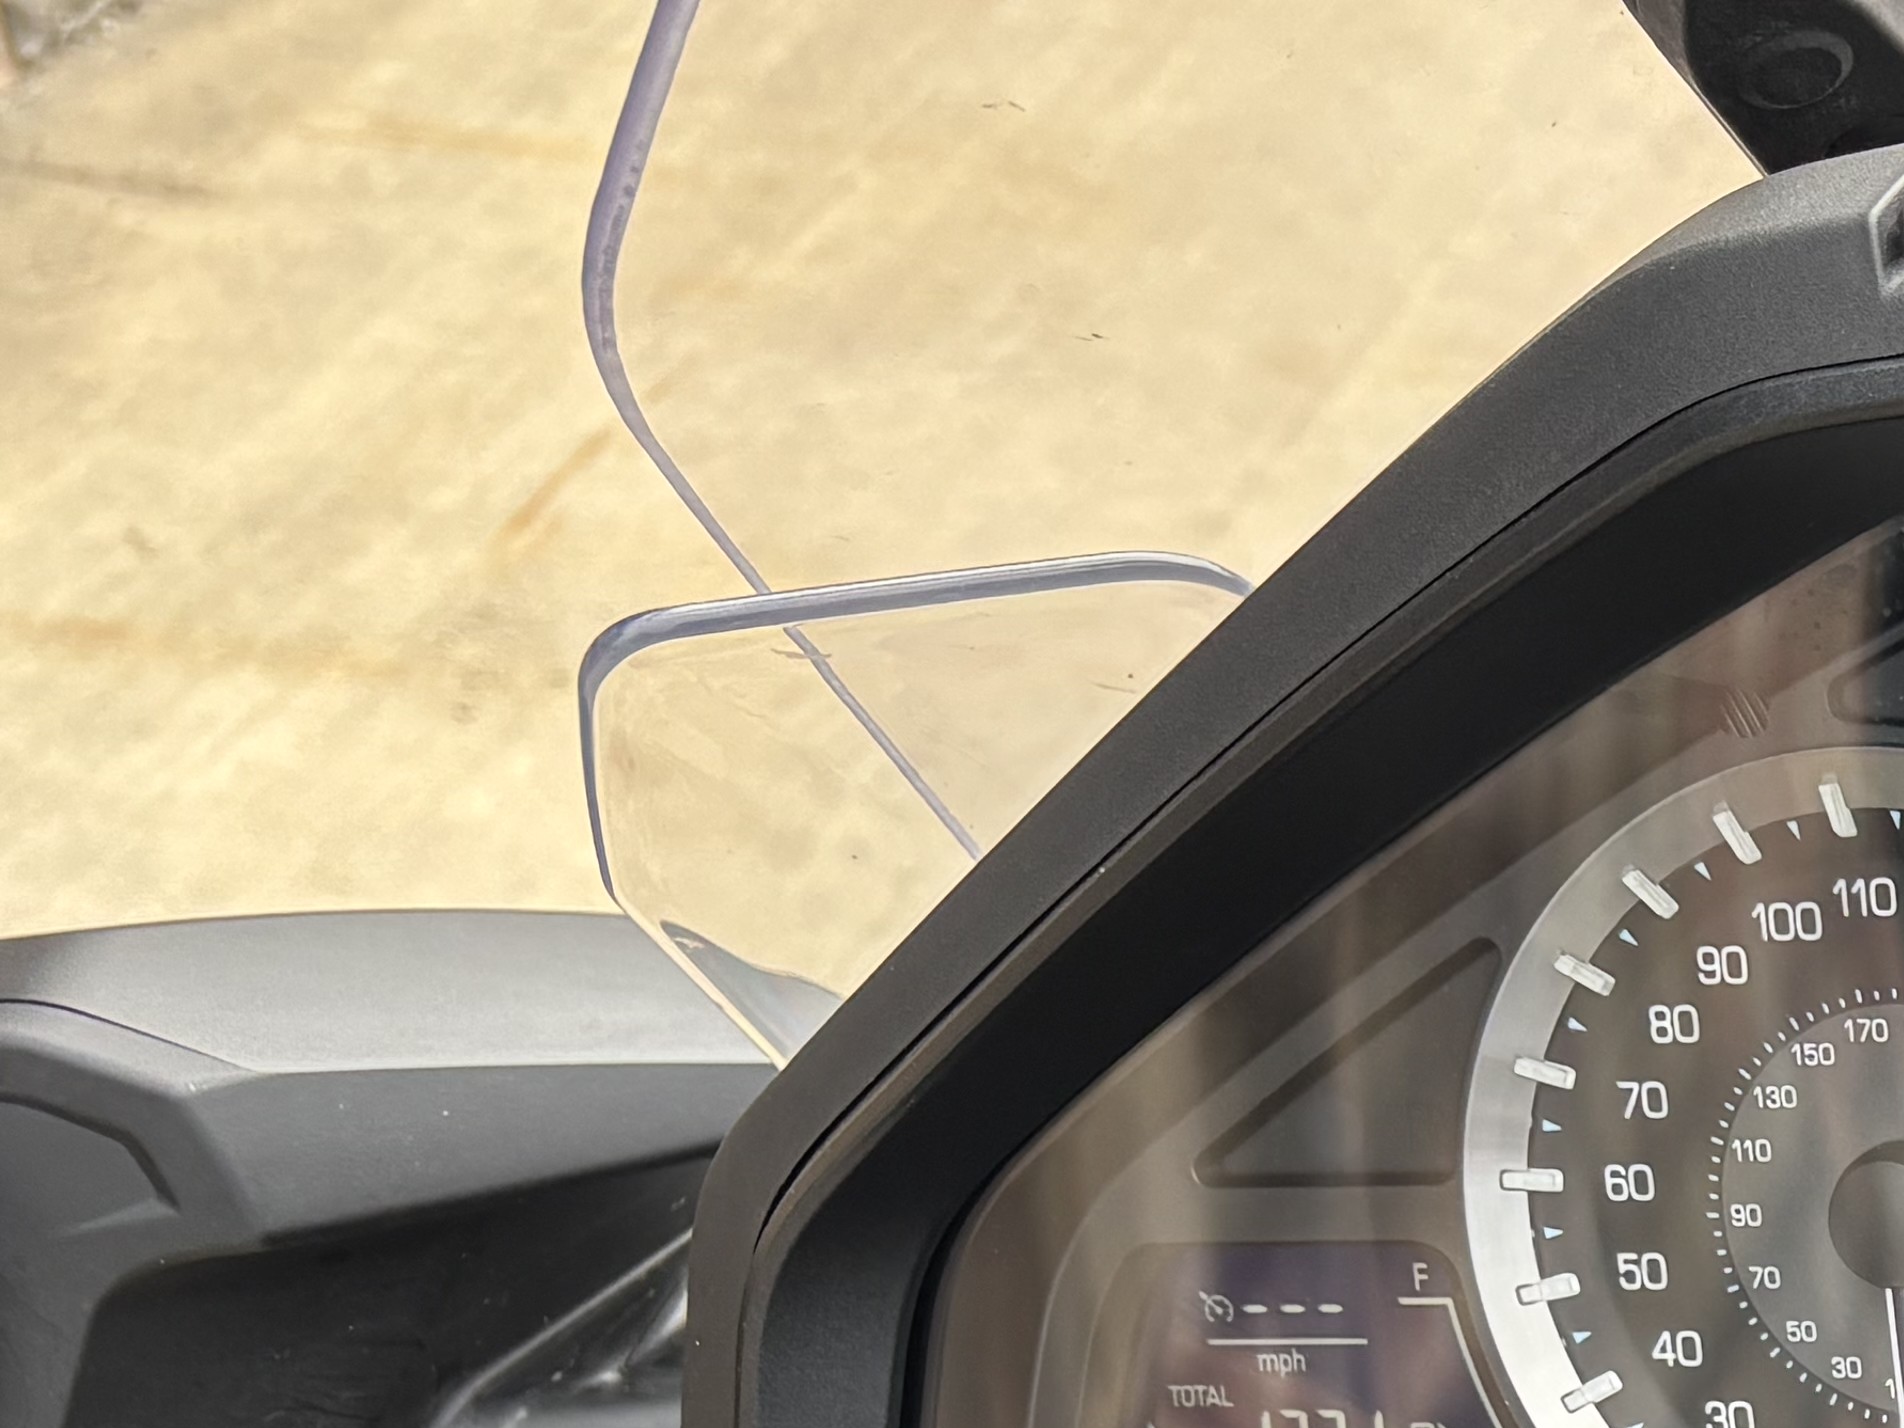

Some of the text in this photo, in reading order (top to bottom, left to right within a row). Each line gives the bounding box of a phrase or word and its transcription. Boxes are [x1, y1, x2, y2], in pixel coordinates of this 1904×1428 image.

[1833, 877, 1897, 917] 110
[1752, 902, 1822, 941] 100
[1697, 945, 1748, 985] 90
[1649, 1004, 1699, 1043] 80
[1844, 1018, 1888, 1042] 170
[1791, 1043, 1835, 1066] 150
[1616, 1081, 1668, 1119] 70
[1753, 1085, 1797, 1109] 130
[1732, 1139, 1771, 1162] 110
[1605, 1164, 1655, 1201] 60
[1730, 1203, 1762, 1227] 90
[1413, 1263, 1428, 1291] F
[1617, 1253, 1667, 1290] 50
[1749, 1266, 1780, 1289] 70
[1786, 1321, 1817, 1342] 50
[1256, 1349, 1306, 1377] mph
[1652, 1331, 1702, 1367] 40
[1831, 1356, 1862, 1378] 30
[1168, 1385, 1234, 1407] TOTAL
